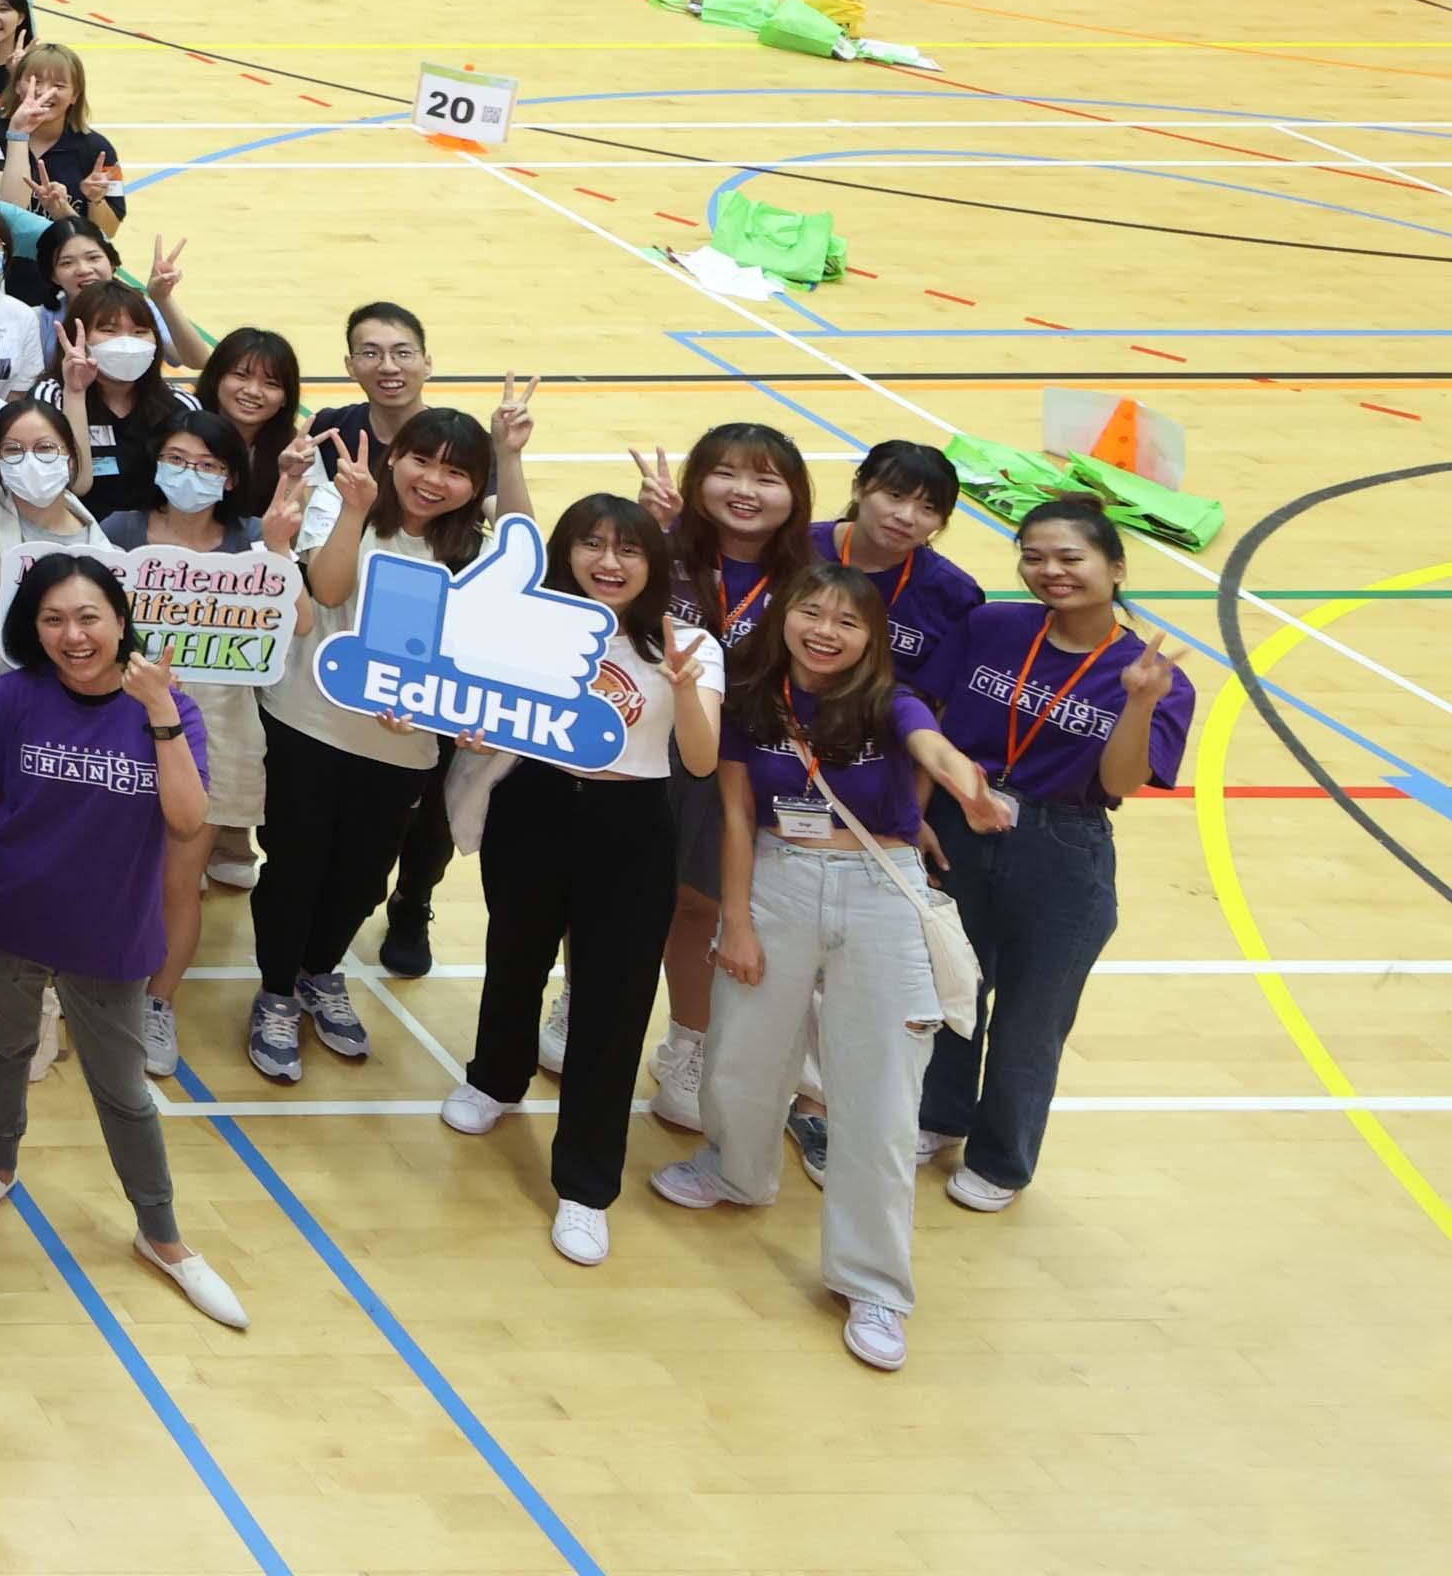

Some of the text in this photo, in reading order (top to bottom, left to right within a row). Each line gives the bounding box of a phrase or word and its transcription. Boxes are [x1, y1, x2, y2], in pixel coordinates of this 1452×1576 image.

[425, 89, 476, 125] 20
[135, 558, 286, 597] friends
[127, 590, 281, 630] lifetime
[135, 629, 277, 673] UHK!
[363, 660, 579, 754] EdUHK
[45, 740, 127, 758] EMBRACE
